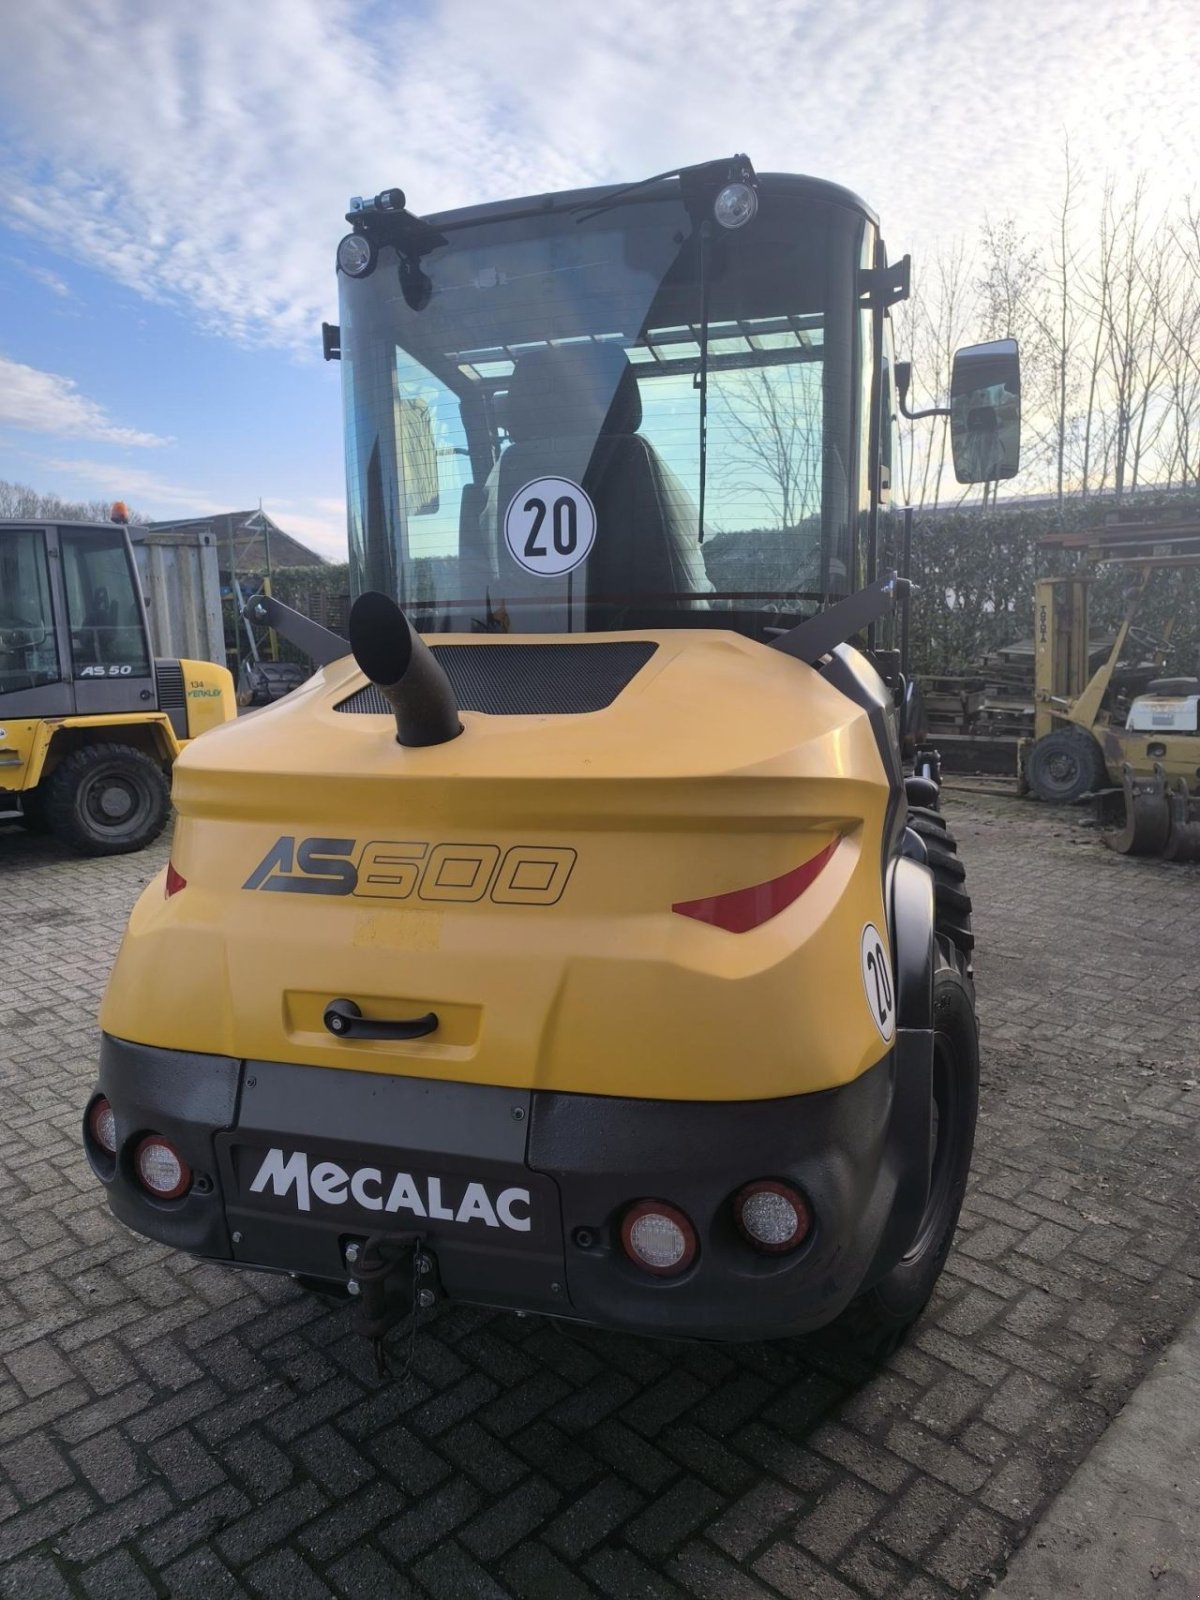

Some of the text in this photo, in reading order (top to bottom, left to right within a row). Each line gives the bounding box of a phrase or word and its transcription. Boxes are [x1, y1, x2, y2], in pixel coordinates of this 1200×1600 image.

[523, 496, 577, 557] 20
[80, 665, 132, 676] AS 50
[190, 680, 204, 688] 134
[867, 943, 892, 1026] 20
